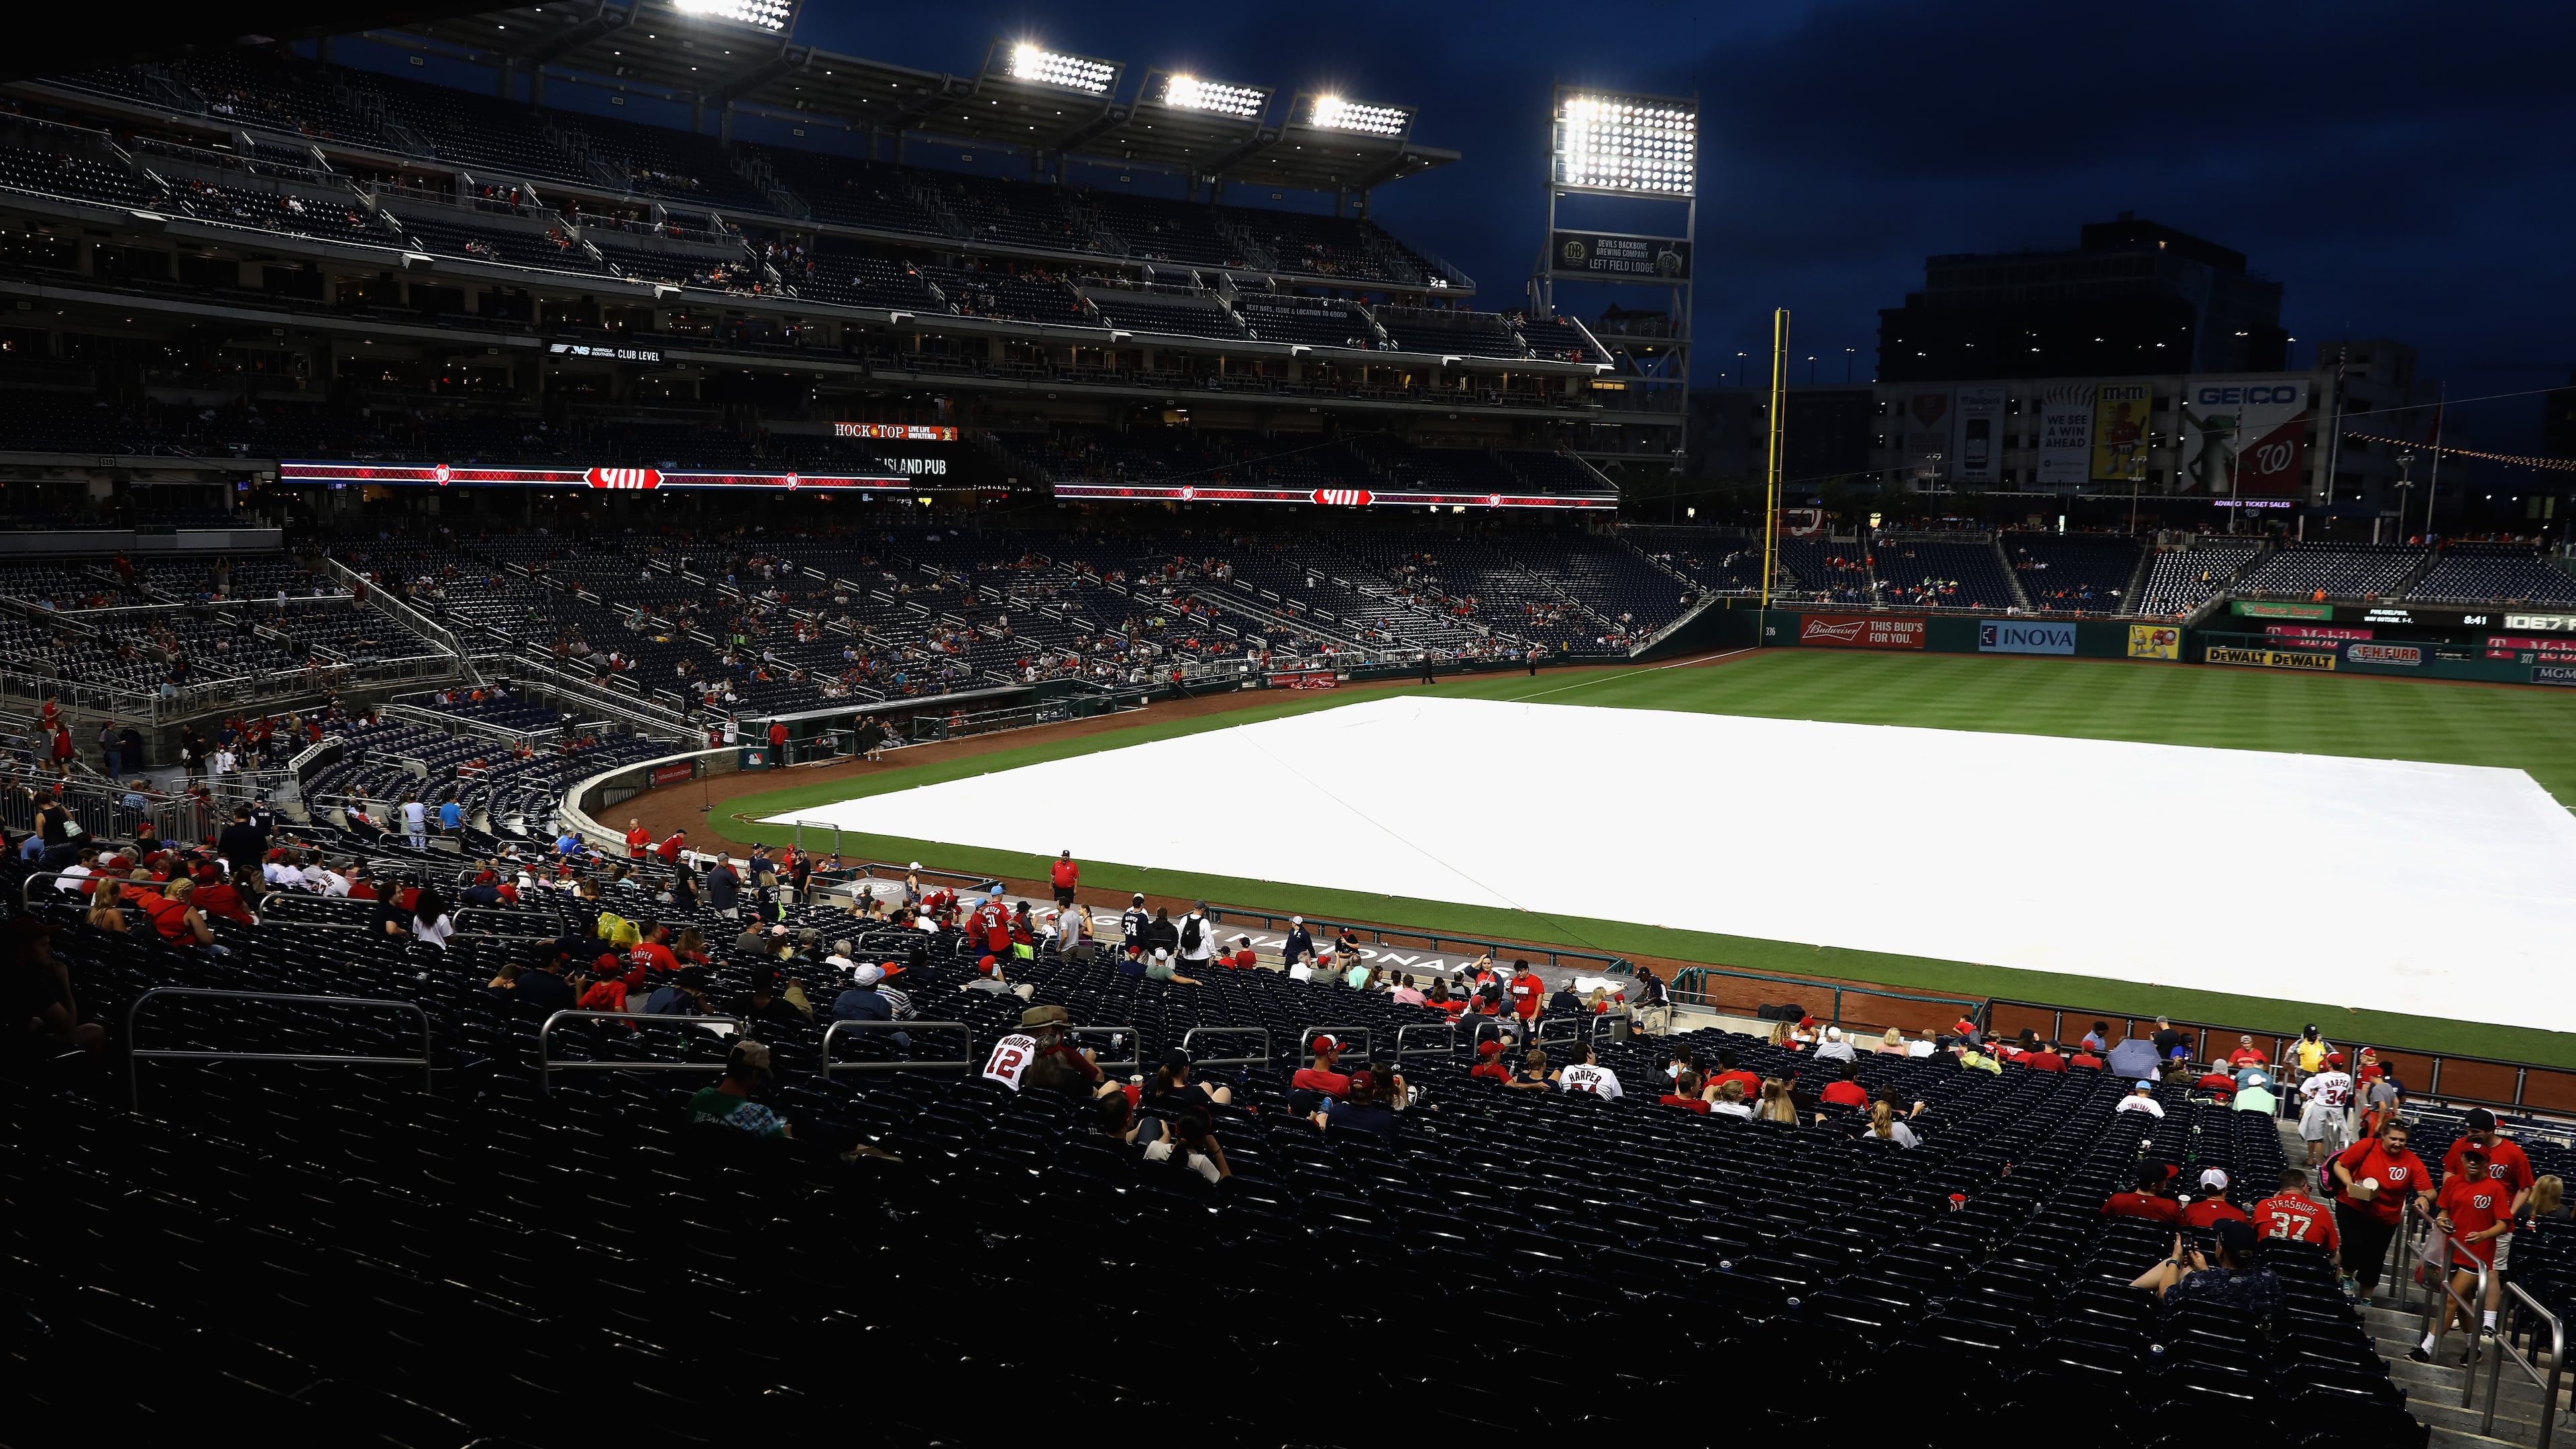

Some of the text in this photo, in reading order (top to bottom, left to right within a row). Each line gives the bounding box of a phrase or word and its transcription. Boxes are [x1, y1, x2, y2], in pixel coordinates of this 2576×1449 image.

[1567, 244, 1581, 257] DB
[1598, 239, 1648, 250] DEVILS BACKBONE
[1596, 248, 1648, 258] BREWING COMPANY
[1589, 259, 1654, 273] LEFT FIELD LODGE
[1260, 305, 1274, 313] NATS,
[1275, 307, 1290, 315] ISSUE
[618, 350, 660, 361] CLUB LEVEL
[2199, 386, 2296, 405] GEICO
[2047, 415, 2087, 424] WE SEE
[835, 424, 904, 438] HOCK TOP
[908, 432, 936, 440] UNFILTERED
[2048, 427, 2084, 436] A WIN
[2046, 438, 2086, 447] AHEAD
[925, 460, 946, 474] PUB
[1870, 621, 1923, 633] THIS BUD'S
[2463, 616, 2487, 625] 8:41
[2505, 616, 2562, 630] 106.7
[1766, 627, 1776, 636] 336
[1808, 623, 1858, 635] Budweiser
[1869, 633, 1912, 643] FOR YOU.
[2004, 629, 2073, 647] INOVA
[985, 914, 997, 928] 31
[1124, 922, 1137, 936] 34
[1002, 1036, 1034, 1052] MOORE
[986, 1047, 1023, 1079] 12
[1569, 1070, 1602, 1085] HARPER
[2326, 1089, 2347, 1105] 34
[2267, 1198, 2318, 1217] STRASBURG
[2269, 1212, 2312, 1241] 37
